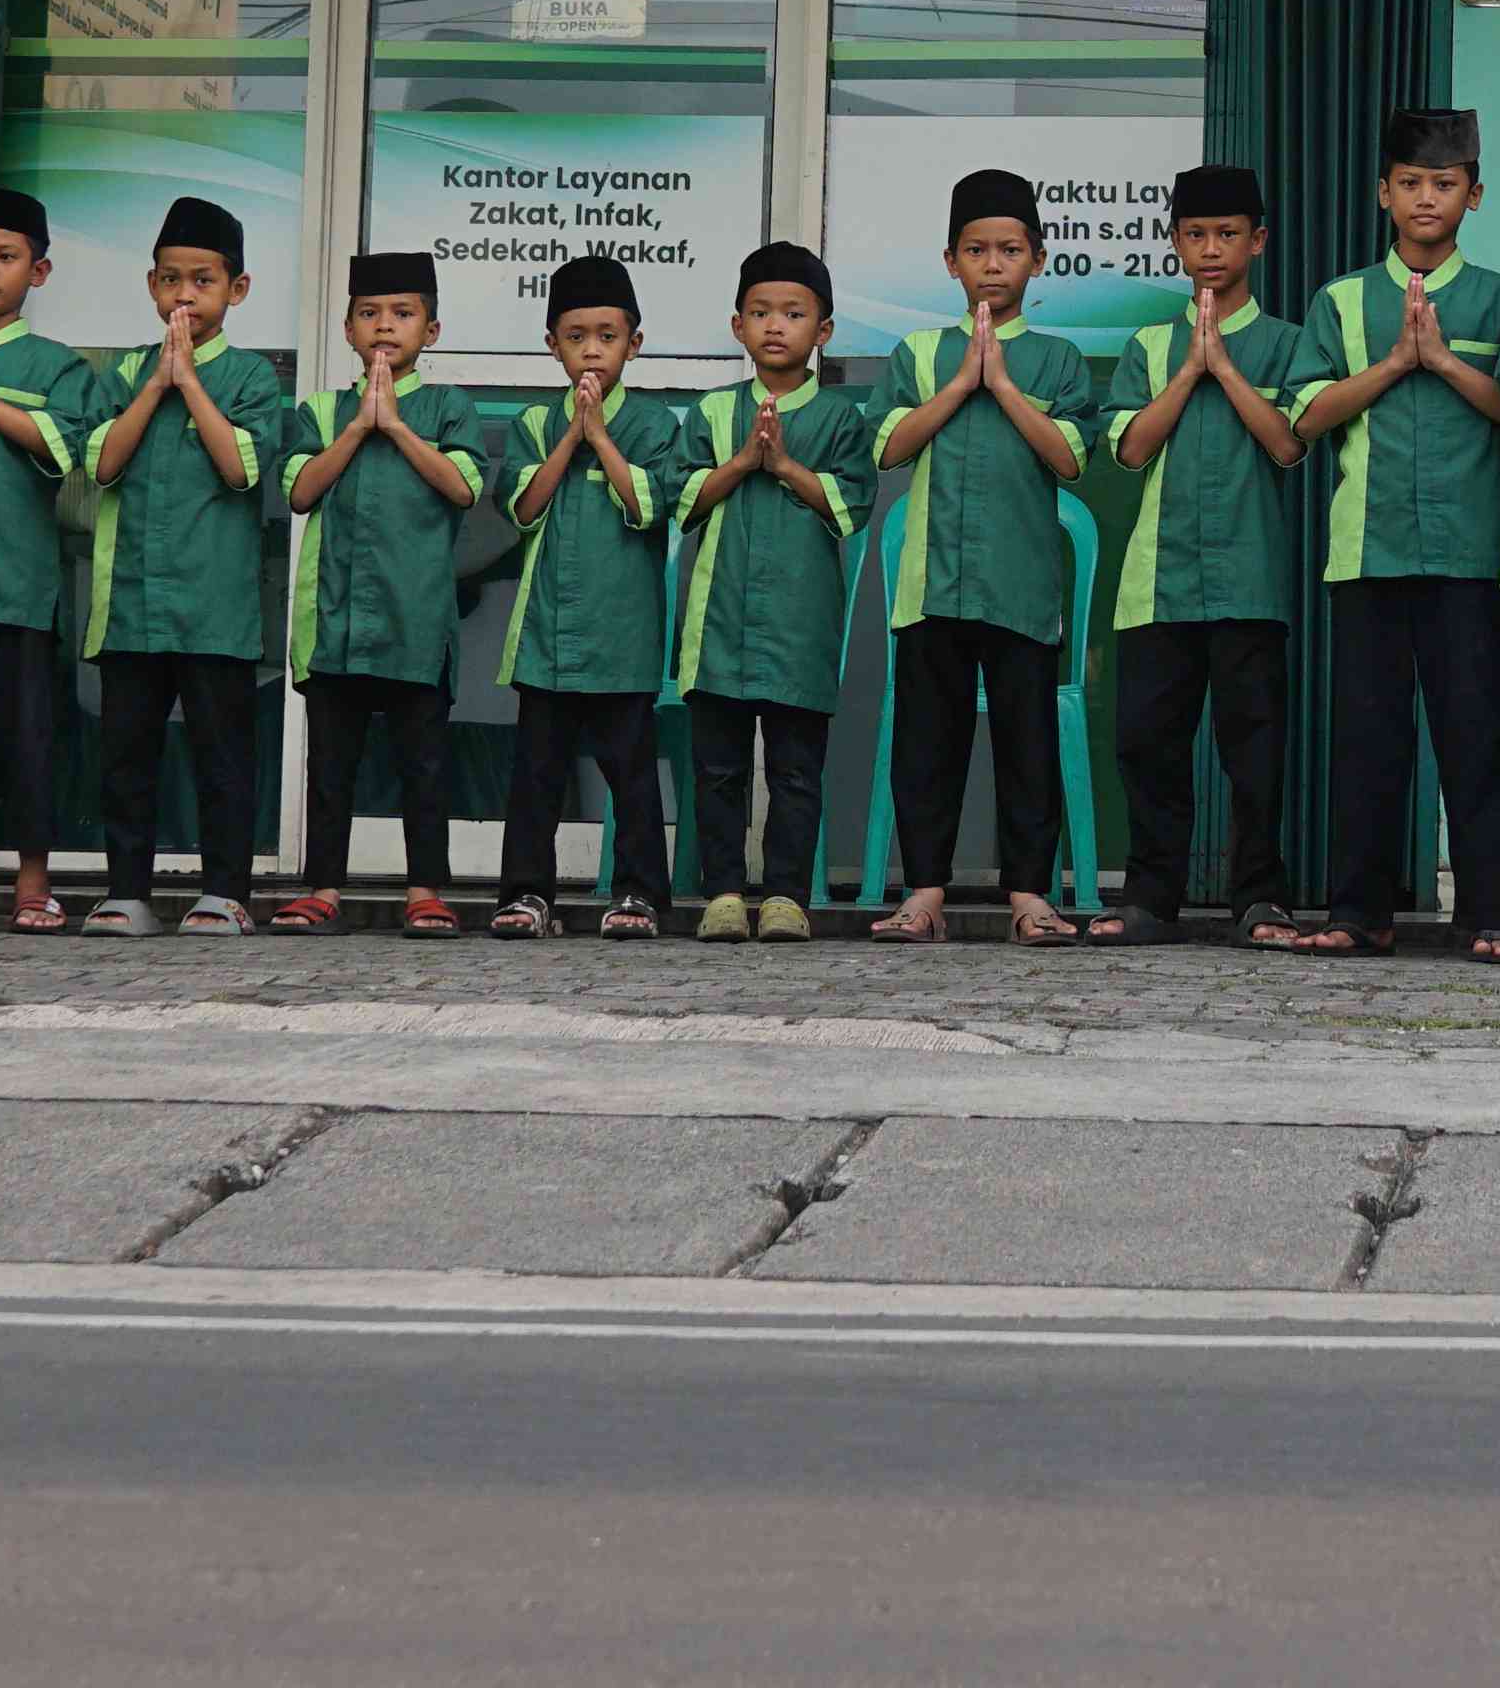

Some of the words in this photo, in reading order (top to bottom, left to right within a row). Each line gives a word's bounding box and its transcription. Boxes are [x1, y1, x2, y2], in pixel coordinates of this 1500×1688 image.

[550, 0, 608, 17] BUKA
[559, 20, 598, 33] OPEN
[442, 164, 549, 189] Kantor
[556, 166, 692, 198] Layanan
[468, 201, 566, 231] Zakat,
[575, 201, 662, 232] Infak,
[1098, 216, 1143, 240] s.d
[586, 238, 697, 269] Wakaf,
[1123, 253, 1188, 277] 21.0
